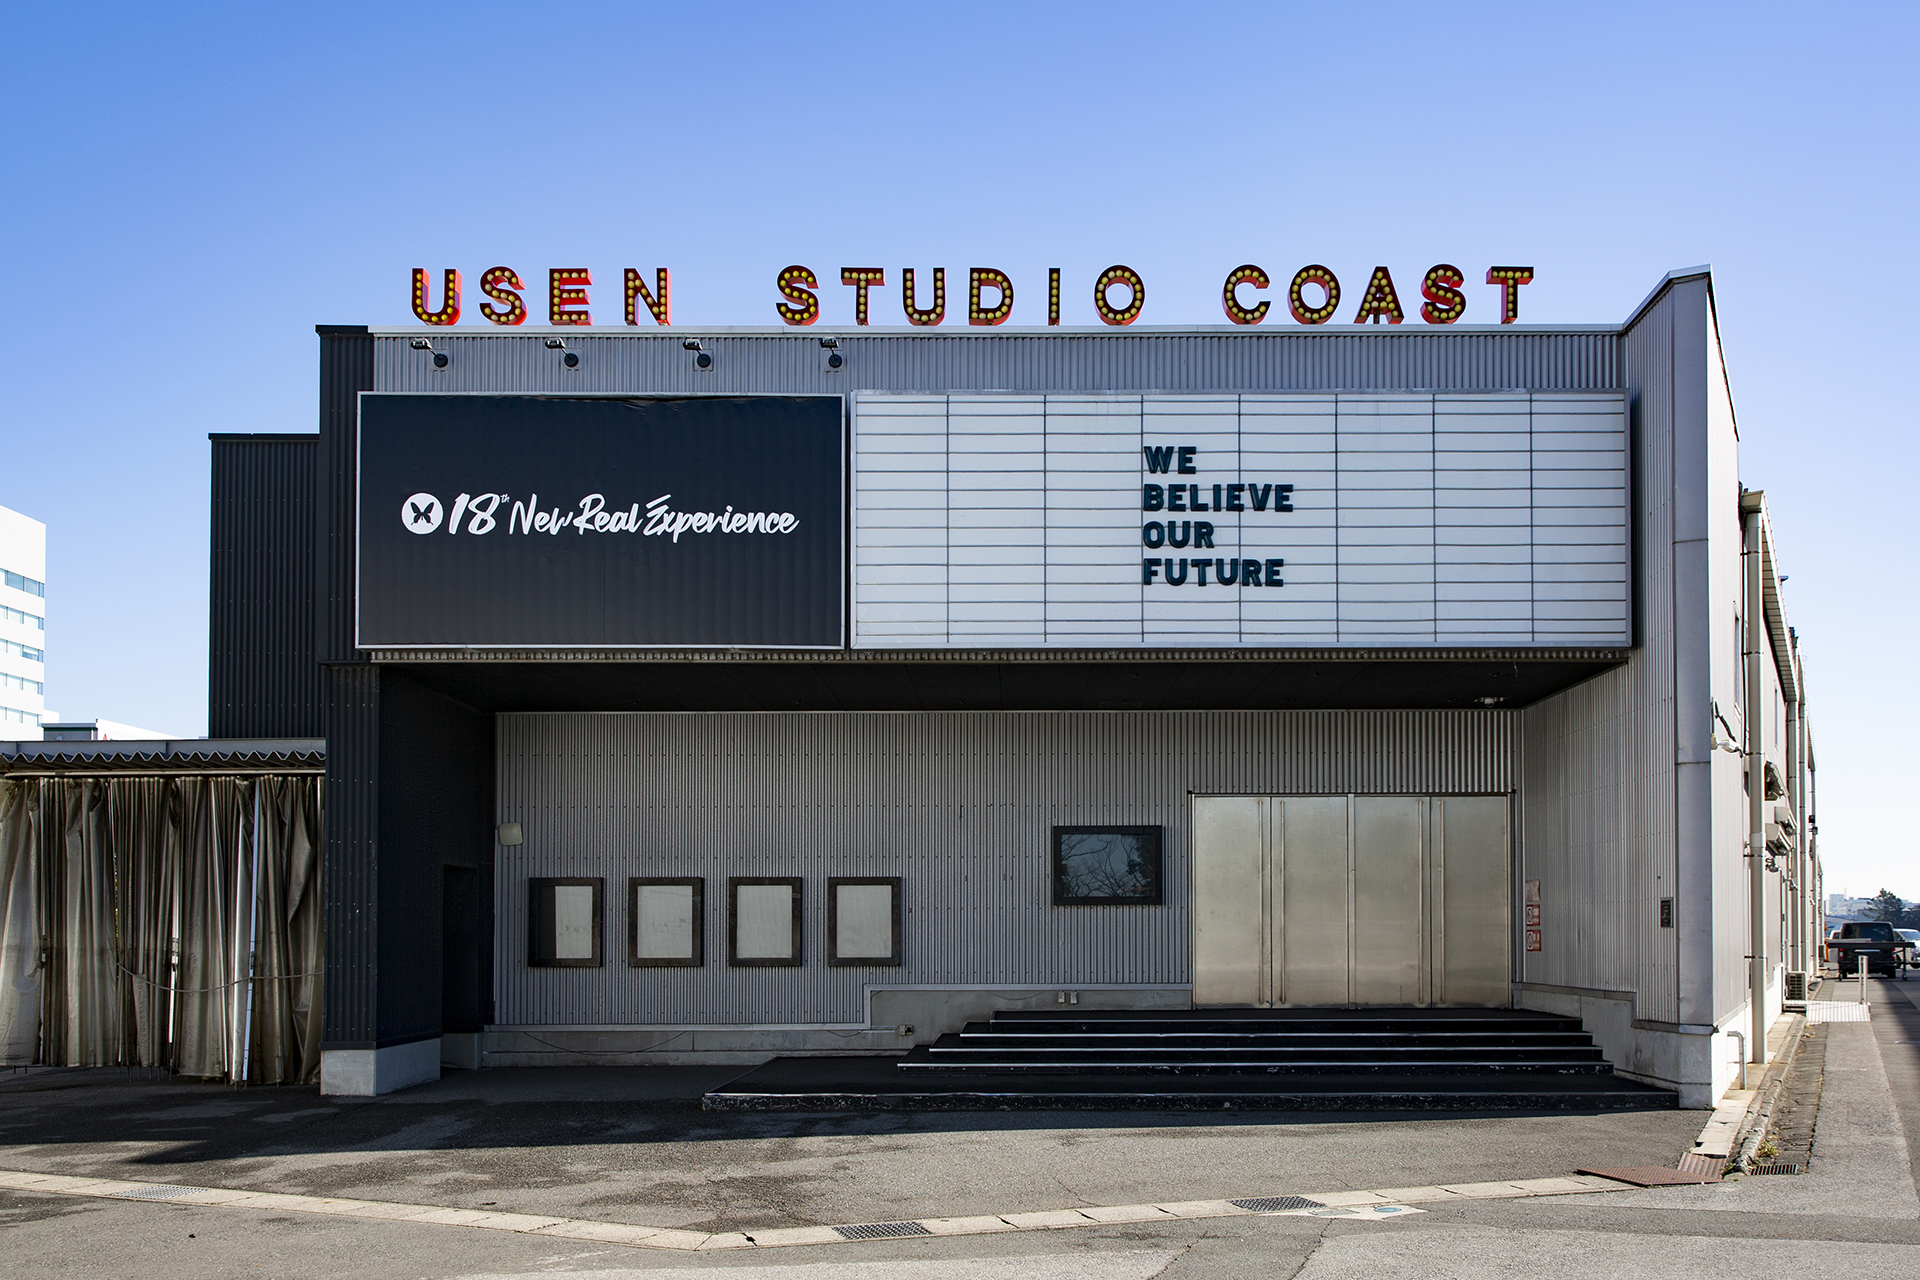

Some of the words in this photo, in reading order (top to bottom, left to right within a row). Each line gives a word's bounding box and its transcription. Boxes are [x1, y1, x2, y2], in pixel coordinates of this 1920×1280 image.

[411, 265, 672, 326] USEN
[775, 264, 1146, 326] STUDIO
[1221, 263, 1534, 326] COAST
[1143, 446, 1197, 475] WE
[1143, 483, 1294, 513] BELIEVE
[509, 493, 574, 535] New
[573, 493, 643, 535] Real
[643, 494, 800, 543] Experience
[1143, 520, 1215, 549] OUR
[1143, 557, 1284, 587] FUTURE
